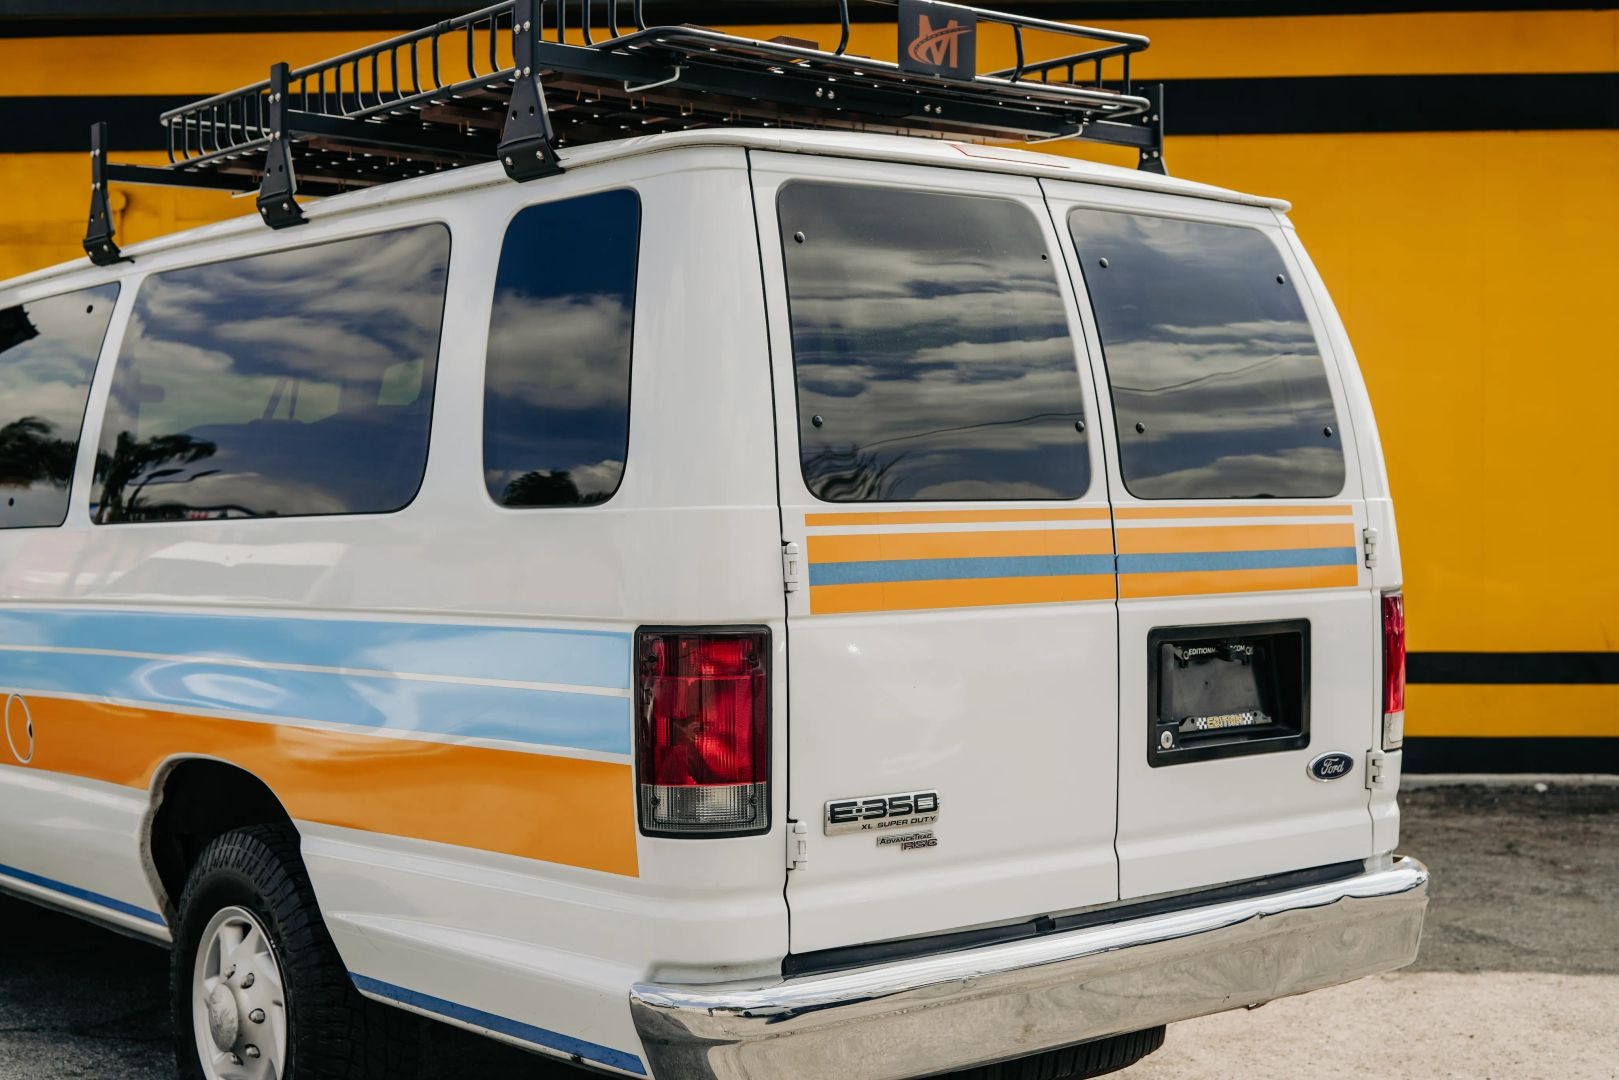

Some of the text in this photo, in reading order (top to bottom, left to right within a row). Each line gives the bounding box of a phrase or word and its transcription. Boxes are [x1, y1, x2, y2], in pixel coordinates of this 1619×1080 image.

[1320, 757, 1345, 775] Ford
[829, 792, 938, 824] E-350
[877, 819, 909, 829] SUPER
[910, 815, 936, 824] DUTY
[902, 838, 938, 851] RSC
